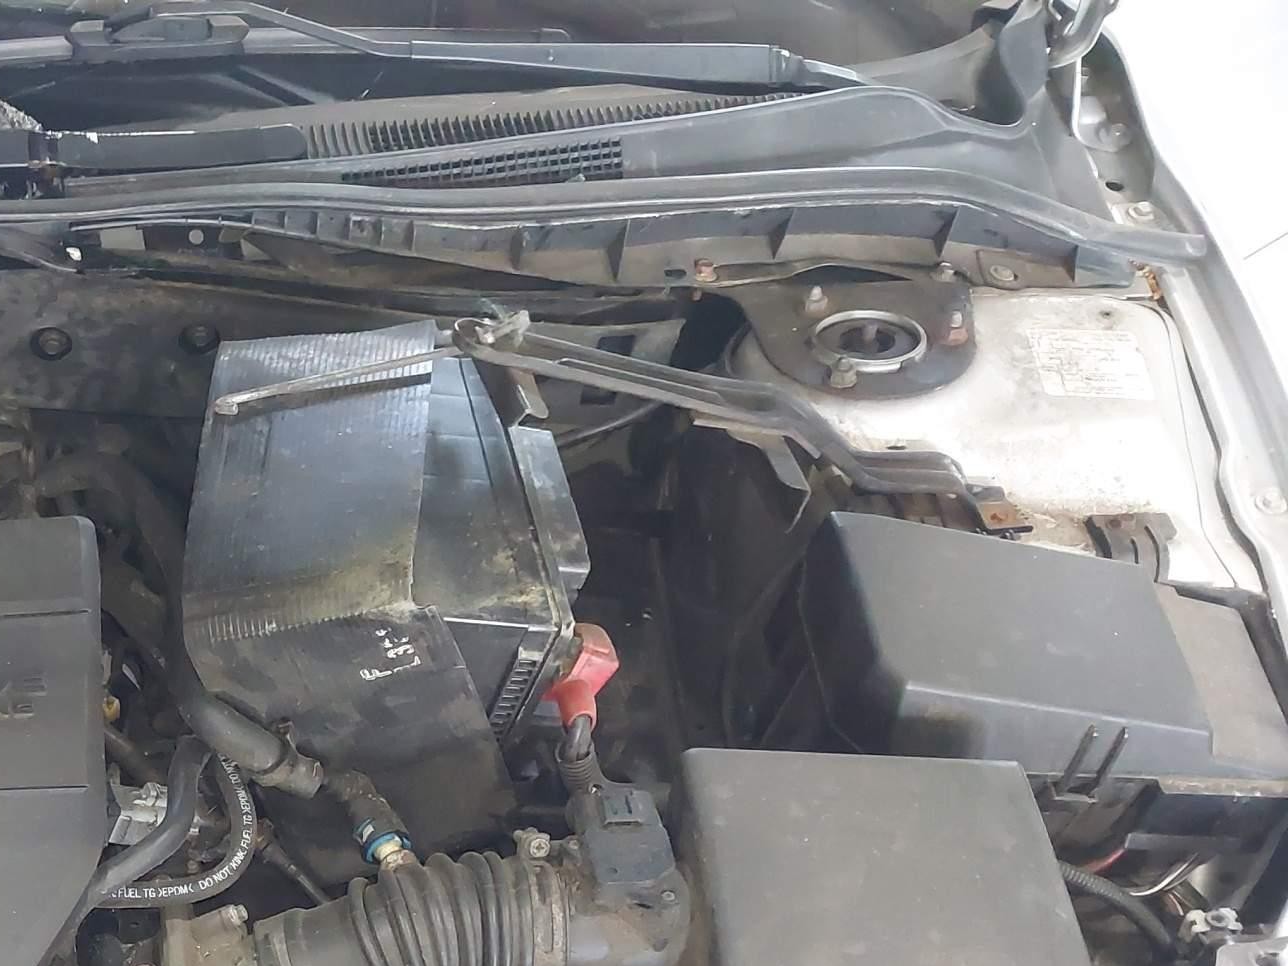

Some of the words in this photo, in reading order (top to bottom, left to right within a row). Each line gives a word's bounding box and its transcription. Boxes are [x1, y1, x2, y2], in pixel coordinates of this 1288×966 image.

[118, 887, 141, 898] FUEL
[143, 888, 156, 898] TG
[199, 877, 213, 890] DO
[212, 865, 233, 883] NOT
